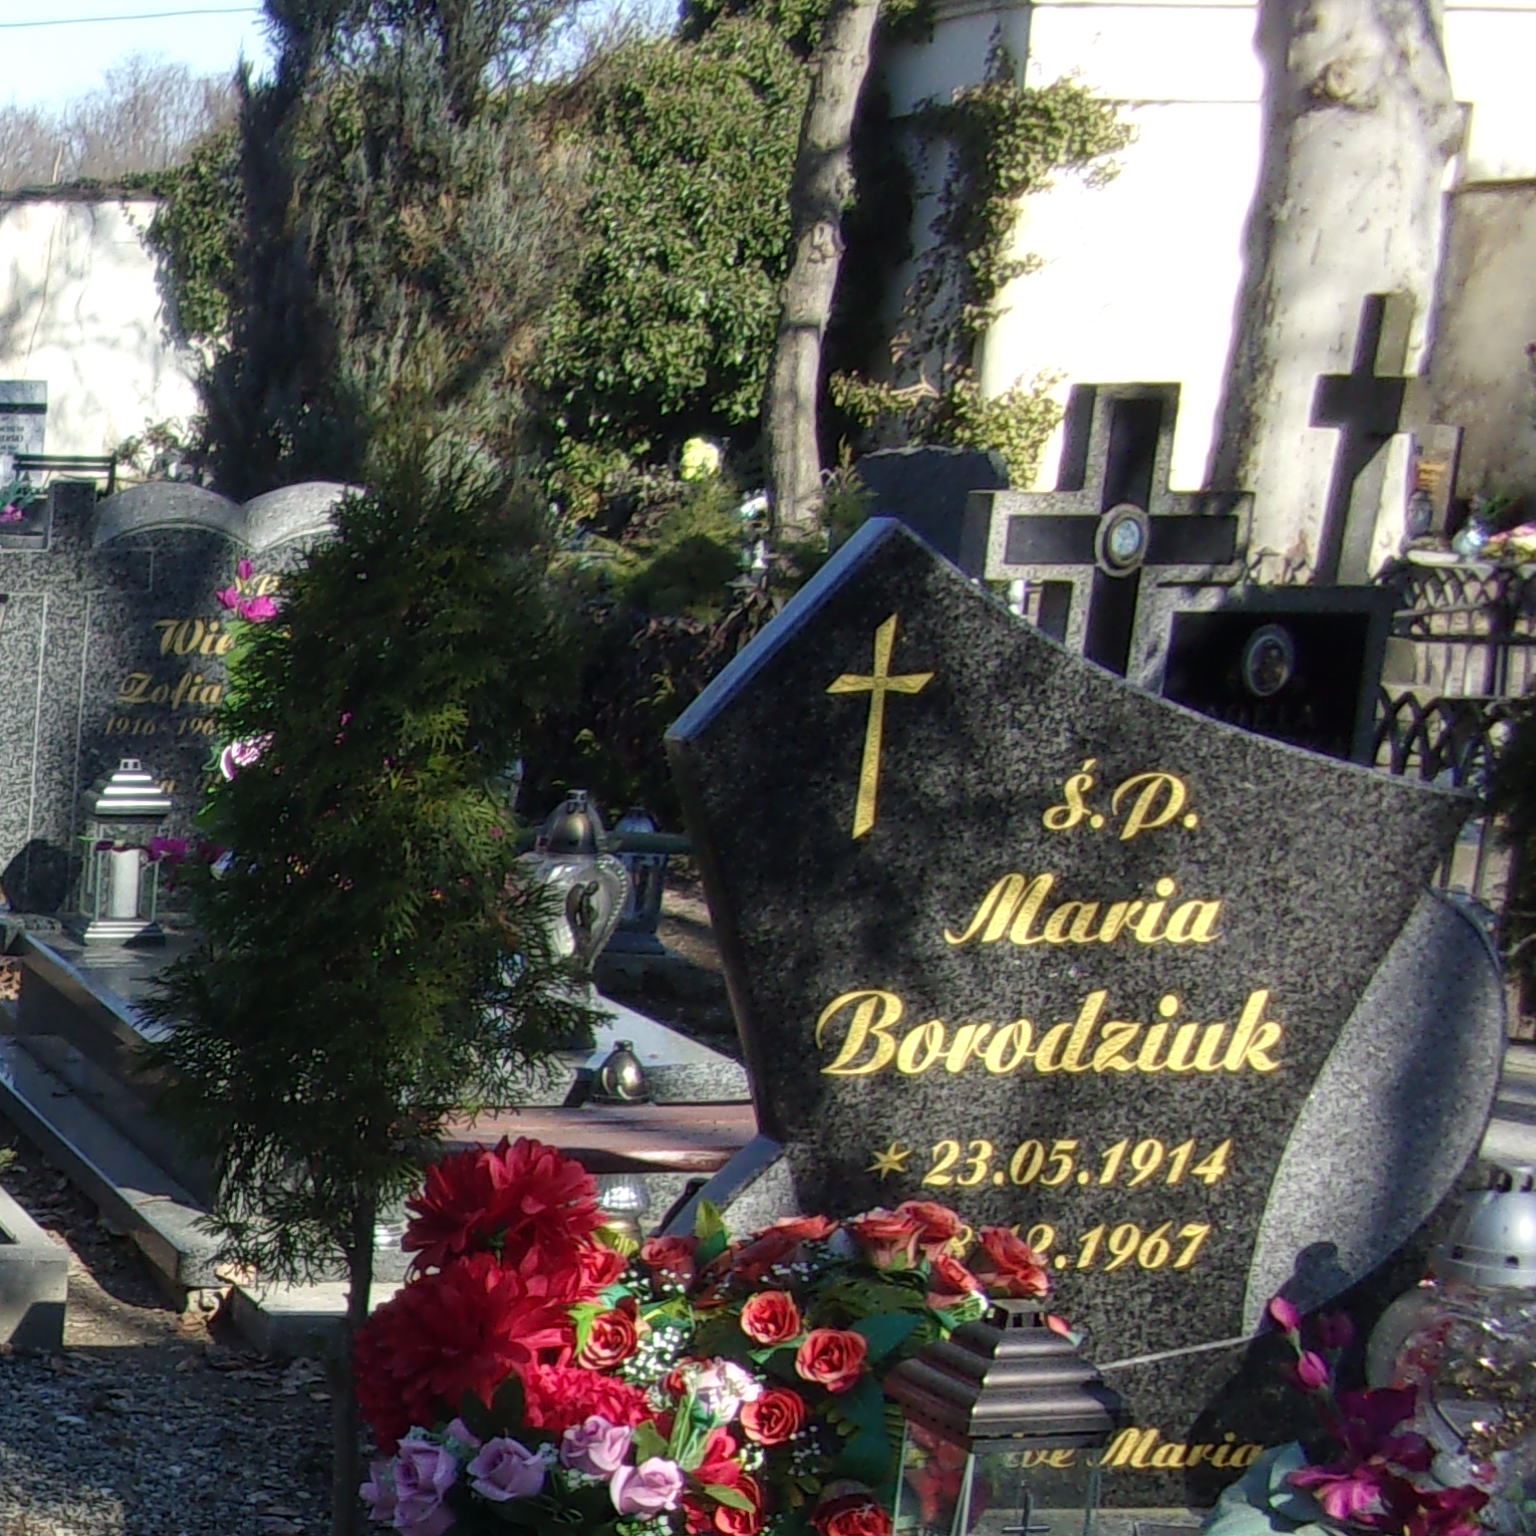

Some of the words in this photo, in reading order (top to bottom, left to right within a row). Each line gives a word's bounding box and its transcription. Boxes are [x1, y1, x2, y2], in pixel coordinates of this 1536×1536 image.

[116, 671, 226, 709] Zofia
[944, 872, 1222, 945] Maria
[815, 989, 1286, 1077] Borodziuk
[923, 1138, 1234, 1188] 23.05.1914
[1085, 1427, 1263, 1469] Maria
